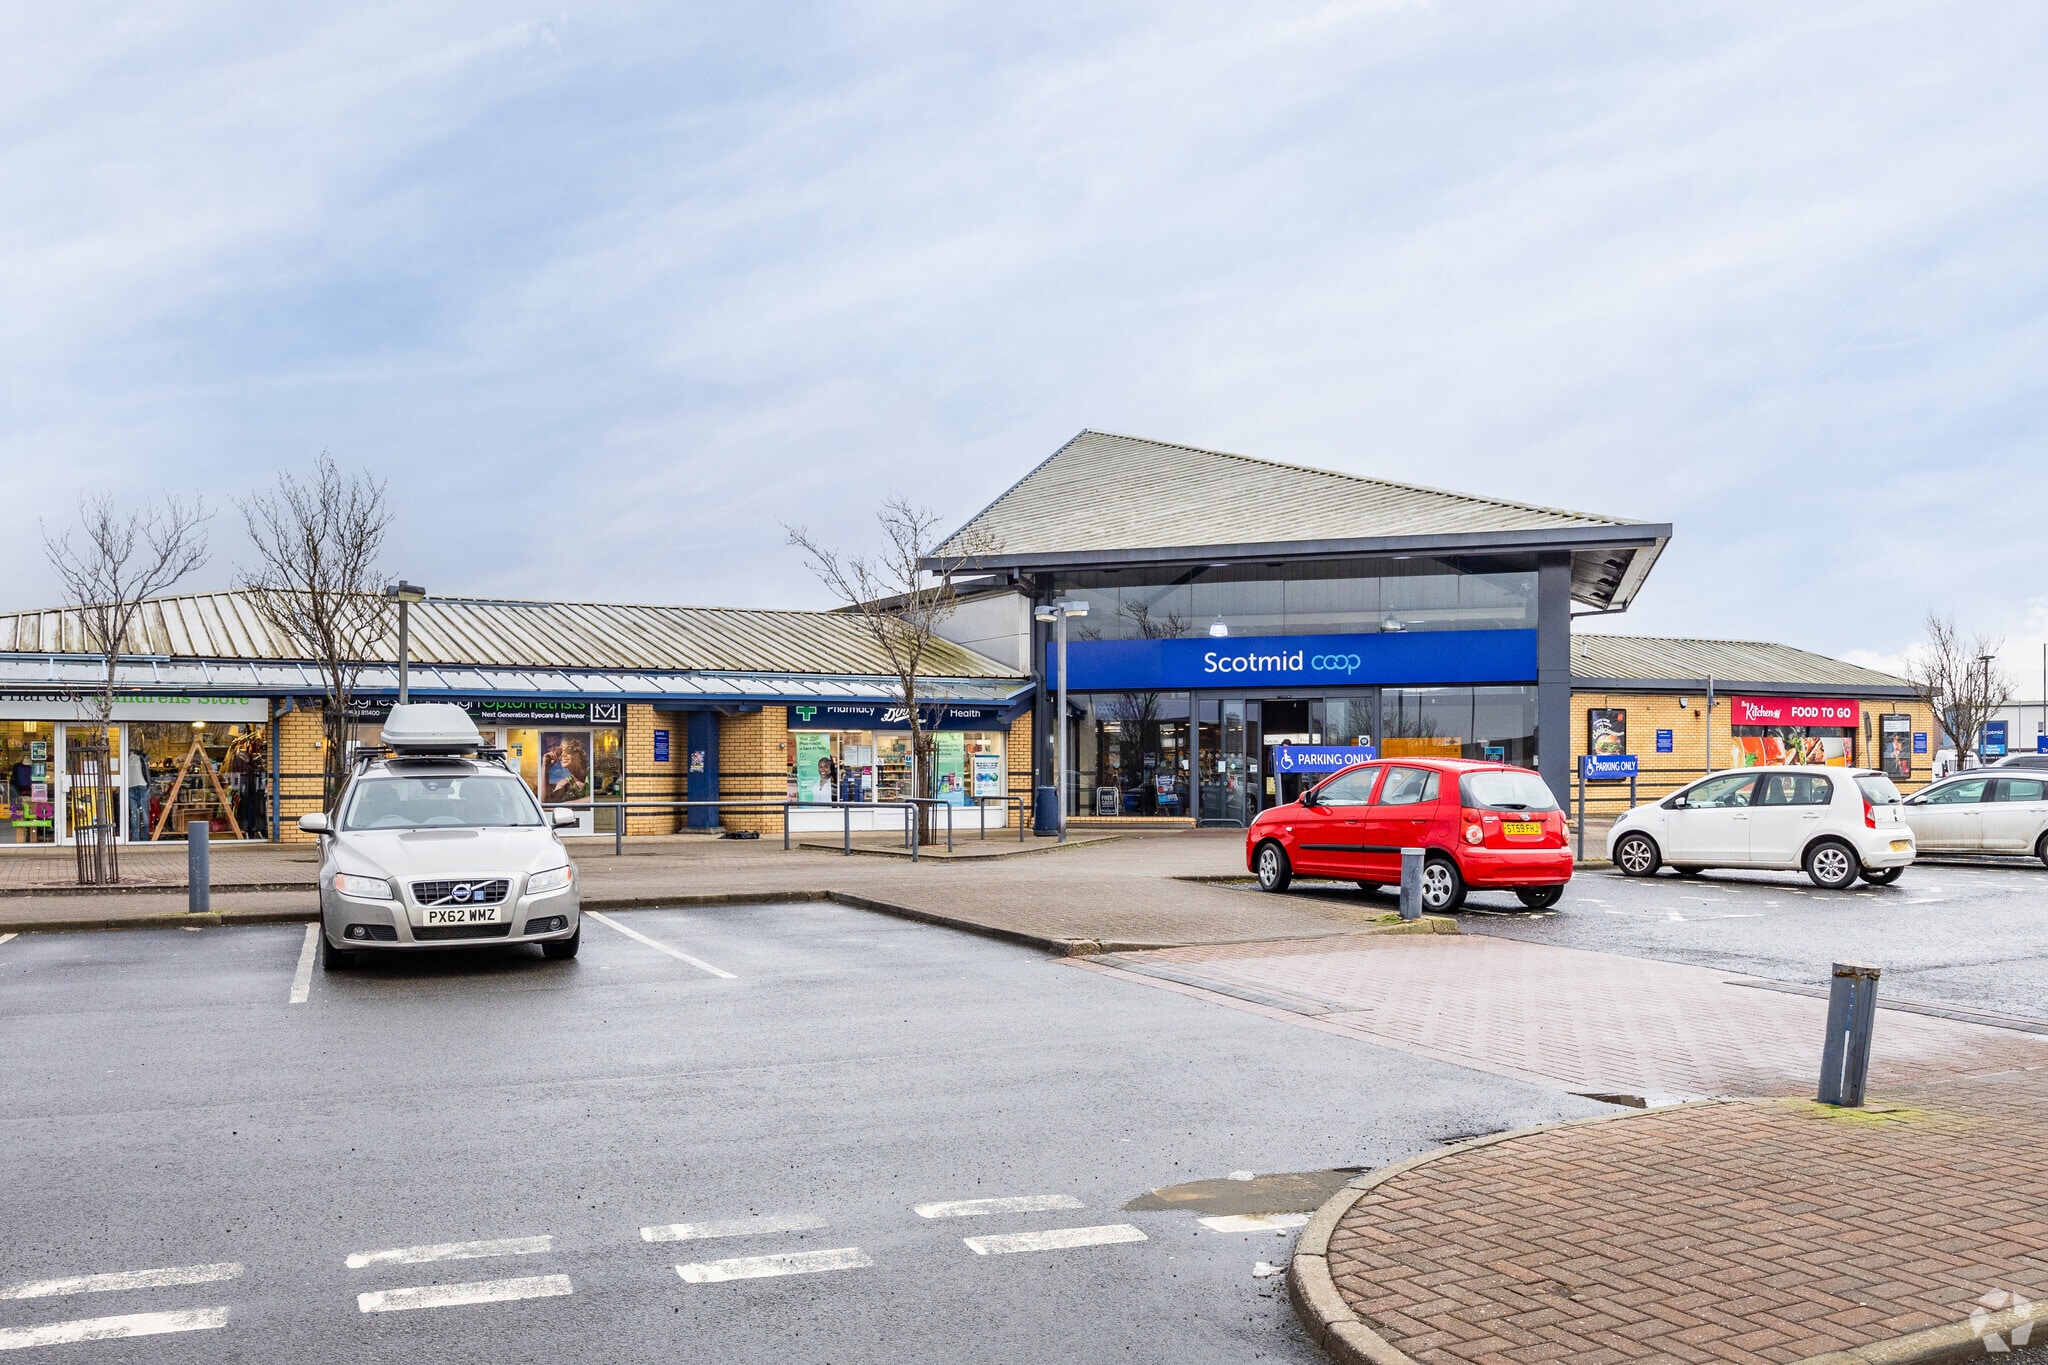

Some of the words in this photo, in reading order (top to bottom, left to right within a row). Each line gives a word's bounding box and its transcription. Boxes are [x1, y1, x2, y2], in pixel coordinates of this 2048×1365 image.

[1204, 650, 1303, 673] Scotmid
[950, 708, 981, 718] Health
[1745, 703, 1774, 721] Kitchen
[1791, 706, 1818, 718] FOOD
[1821, 707, 1834, 718] TO
[1837, 707, 1851, 718] GO
[1298, 753, 1342, 765] PARKING
[1344, 753, 1372, 765] ONLY
[1595, 761, 1620, 772] PARKING
[1620, 760, 1636, 771] ONLY
[1507, 824, 1525, 833] ST59
[429, 910, 465, 923] PX62
[469, 909, 495, 922] WMZ
